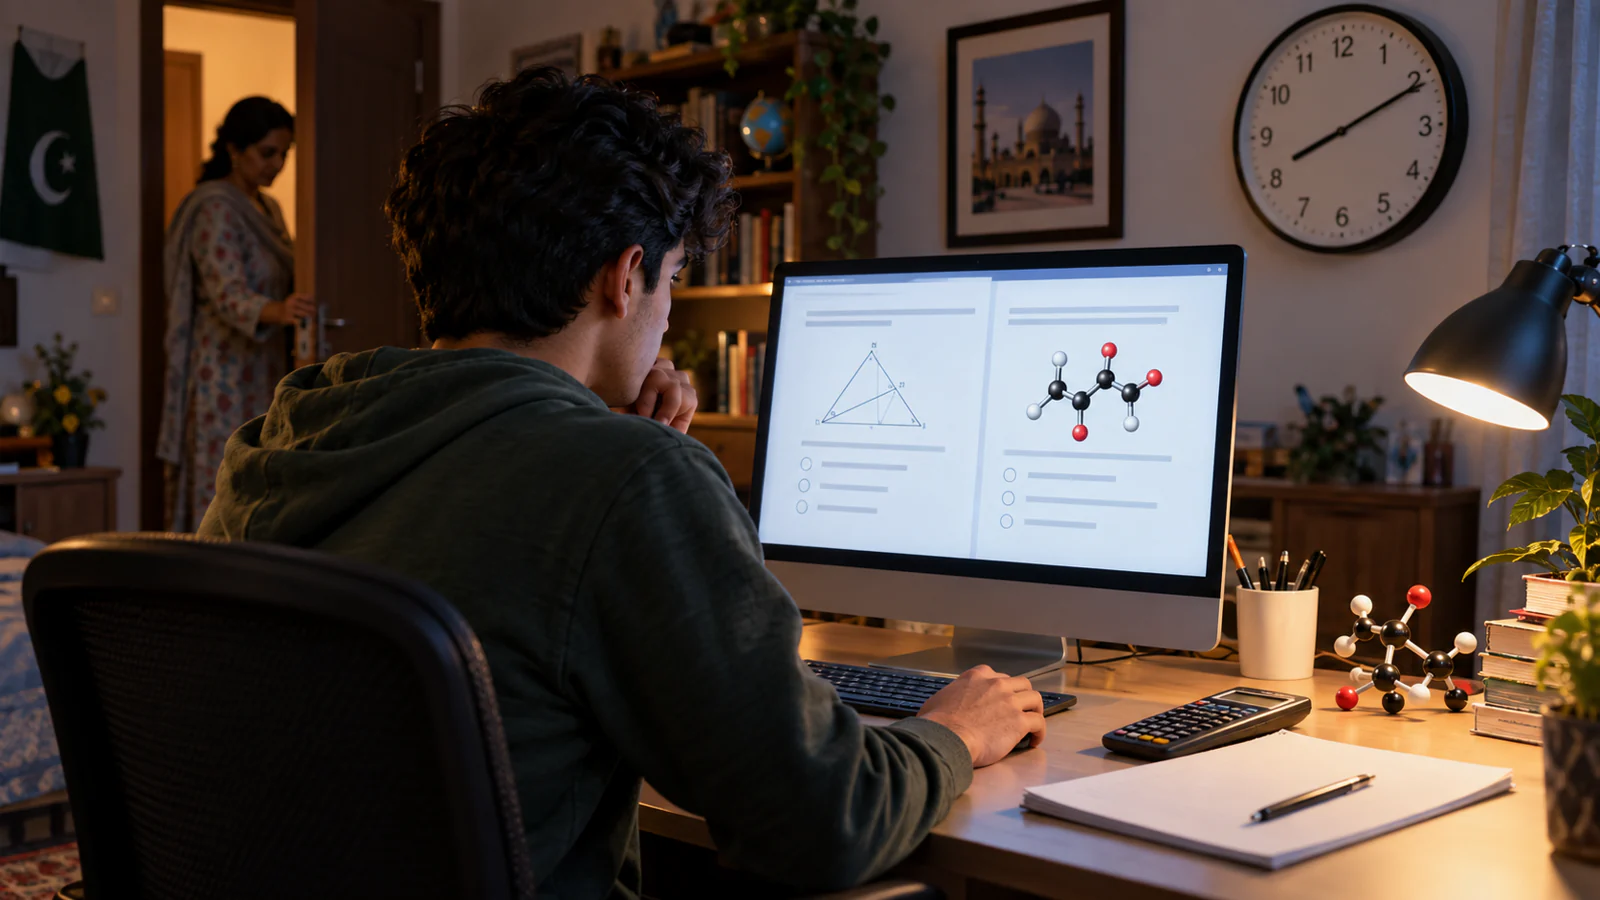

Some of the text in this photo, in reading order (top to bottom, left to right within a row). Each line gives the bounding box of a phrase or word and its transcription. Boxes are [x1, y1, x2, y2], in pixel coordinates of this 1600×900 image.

[1332, 36, 1354, 58] 12
[1379, 43, 1387, 64] 1
[1296, 53, 1313, 73] 11
[1407, 71, 1421, 93] 2
[1270, 84, 1290, 105] 10
[1418, 115, 1432, 136] 3
[1260, 127, 1273, 147] 9
[1270, 168, 1282, 188] 8
[1406, 160, 1420, 180] 4
[1298, 197, 1310, 217] 7
[1377, 193, 1390, 213] 5
[1336, 207, 1349, 227] 6
